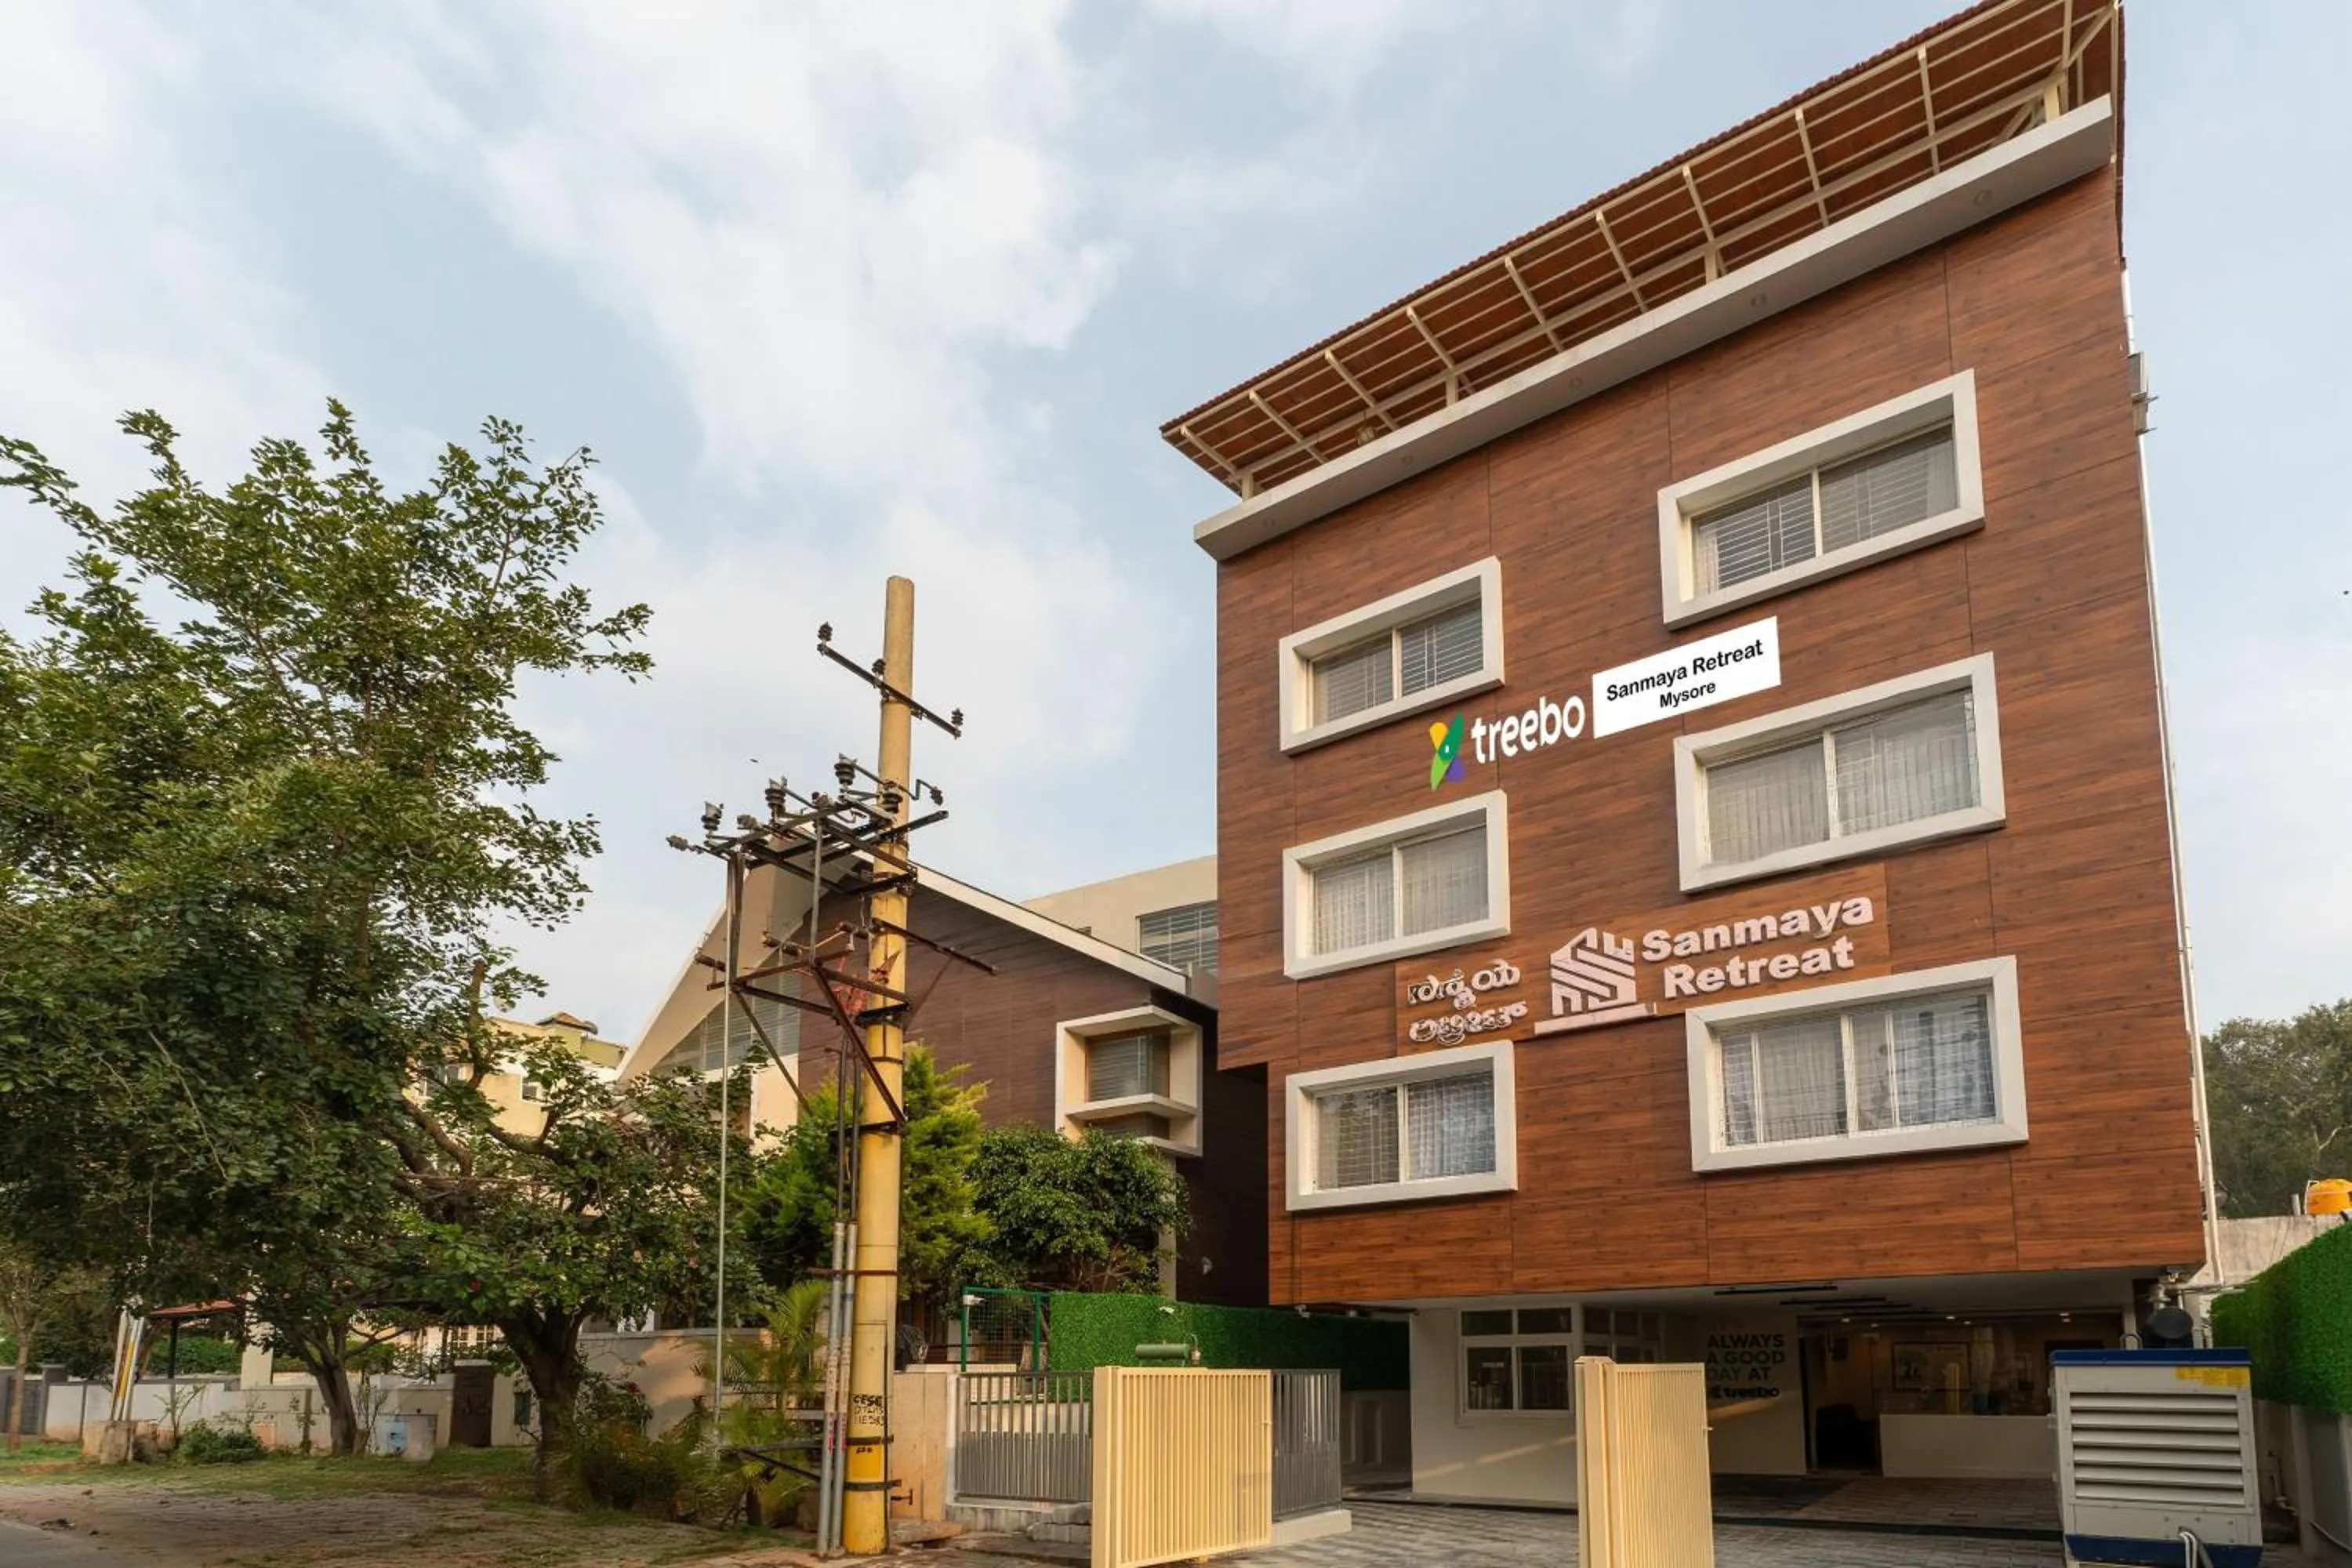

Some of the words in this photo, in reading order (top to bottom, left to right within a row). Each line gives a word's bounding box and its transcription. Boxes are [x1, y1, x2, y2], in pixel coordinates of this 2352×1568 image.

[1606, 666, 1688, 702] Sanmaya
[1693, 639, 1763, 675] Retreat
[1660, 683, 1715, 708] Mysore
[1471, 695, 1585, 764] treebo
[1642, 896, 1874, 961] Sanmaya
[1664, 935, 1855, 999] Retreat
[1707, 1351, 1719, 1363] A
[1724, 1350, 1785, 1364] GOOD
[1708, 1334, 1784, 1348] ALWAYS
[1748, 1367, 1772, 1381] AT
